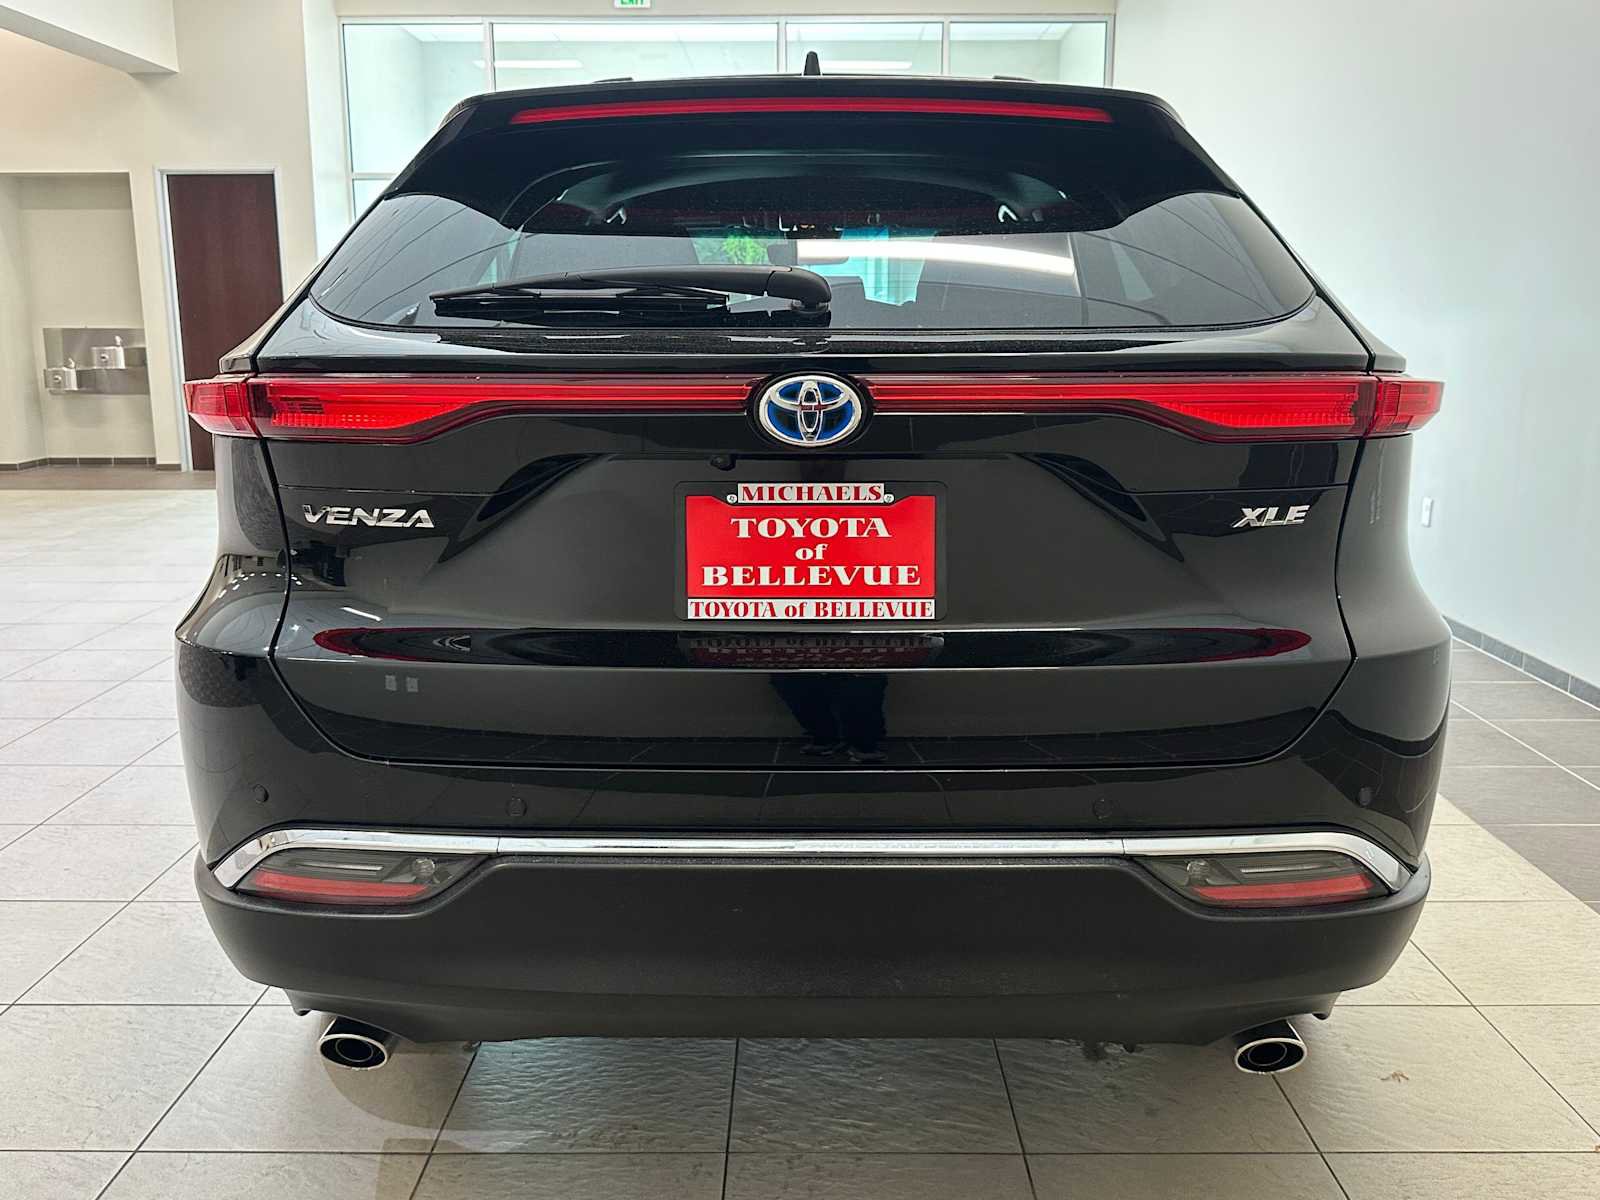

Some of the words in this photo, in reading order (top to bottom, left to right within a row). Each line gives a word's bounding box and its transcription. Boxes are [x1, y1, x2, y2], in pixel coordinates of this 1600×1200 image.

[740, 485, 882, 502] MICHAELS
[302, 504, 435, 528] VENZA
[1230, 505, 1310, 528] XLE
[731, 517, 892, 538] TOYOTA
[795, 543, 829, 560] of
[702, 565, 921, 586] BELLEVUE
[690, 601, 777, 617] TOYOTA
[784, 601, 807, 617] of
[814, 601, 933, 617] BELLEVUE
